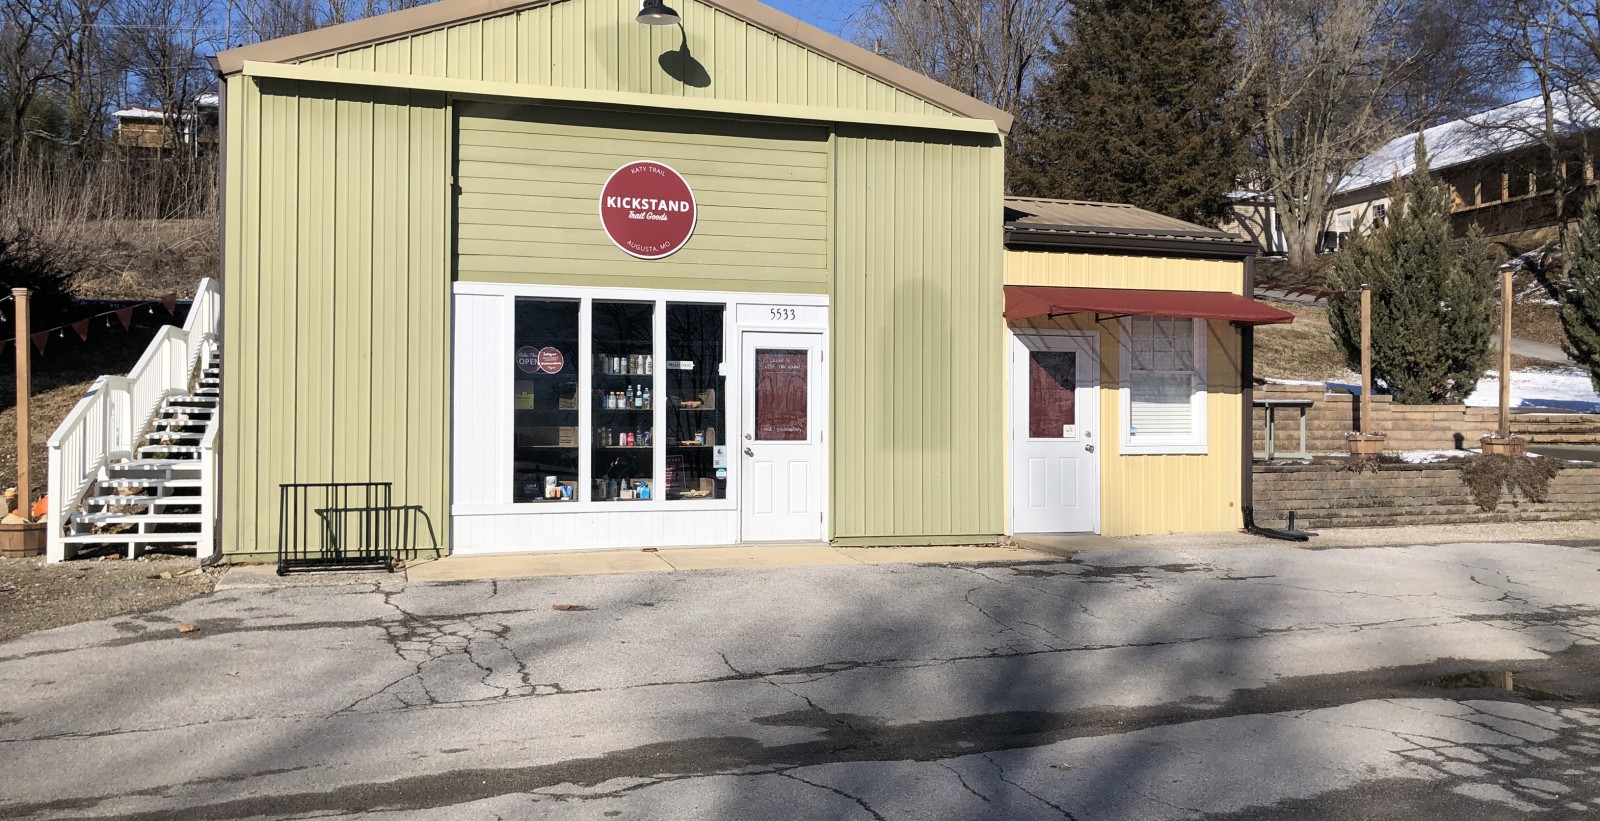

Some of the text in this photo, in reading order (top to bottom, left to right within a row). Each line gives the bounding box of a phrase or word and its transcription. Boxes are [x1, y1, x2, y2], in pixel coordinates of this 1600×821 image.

[630, 166, 666, 177] KATY TRAIL
[606, 196, 690, 213] KICKSTAND
[628, 210, 669, 221] Trail Goods
[660, 240, 671, 250] MO
[770, 307, 796, 321] 5533
[518, 358, 538, 366] OPEN
